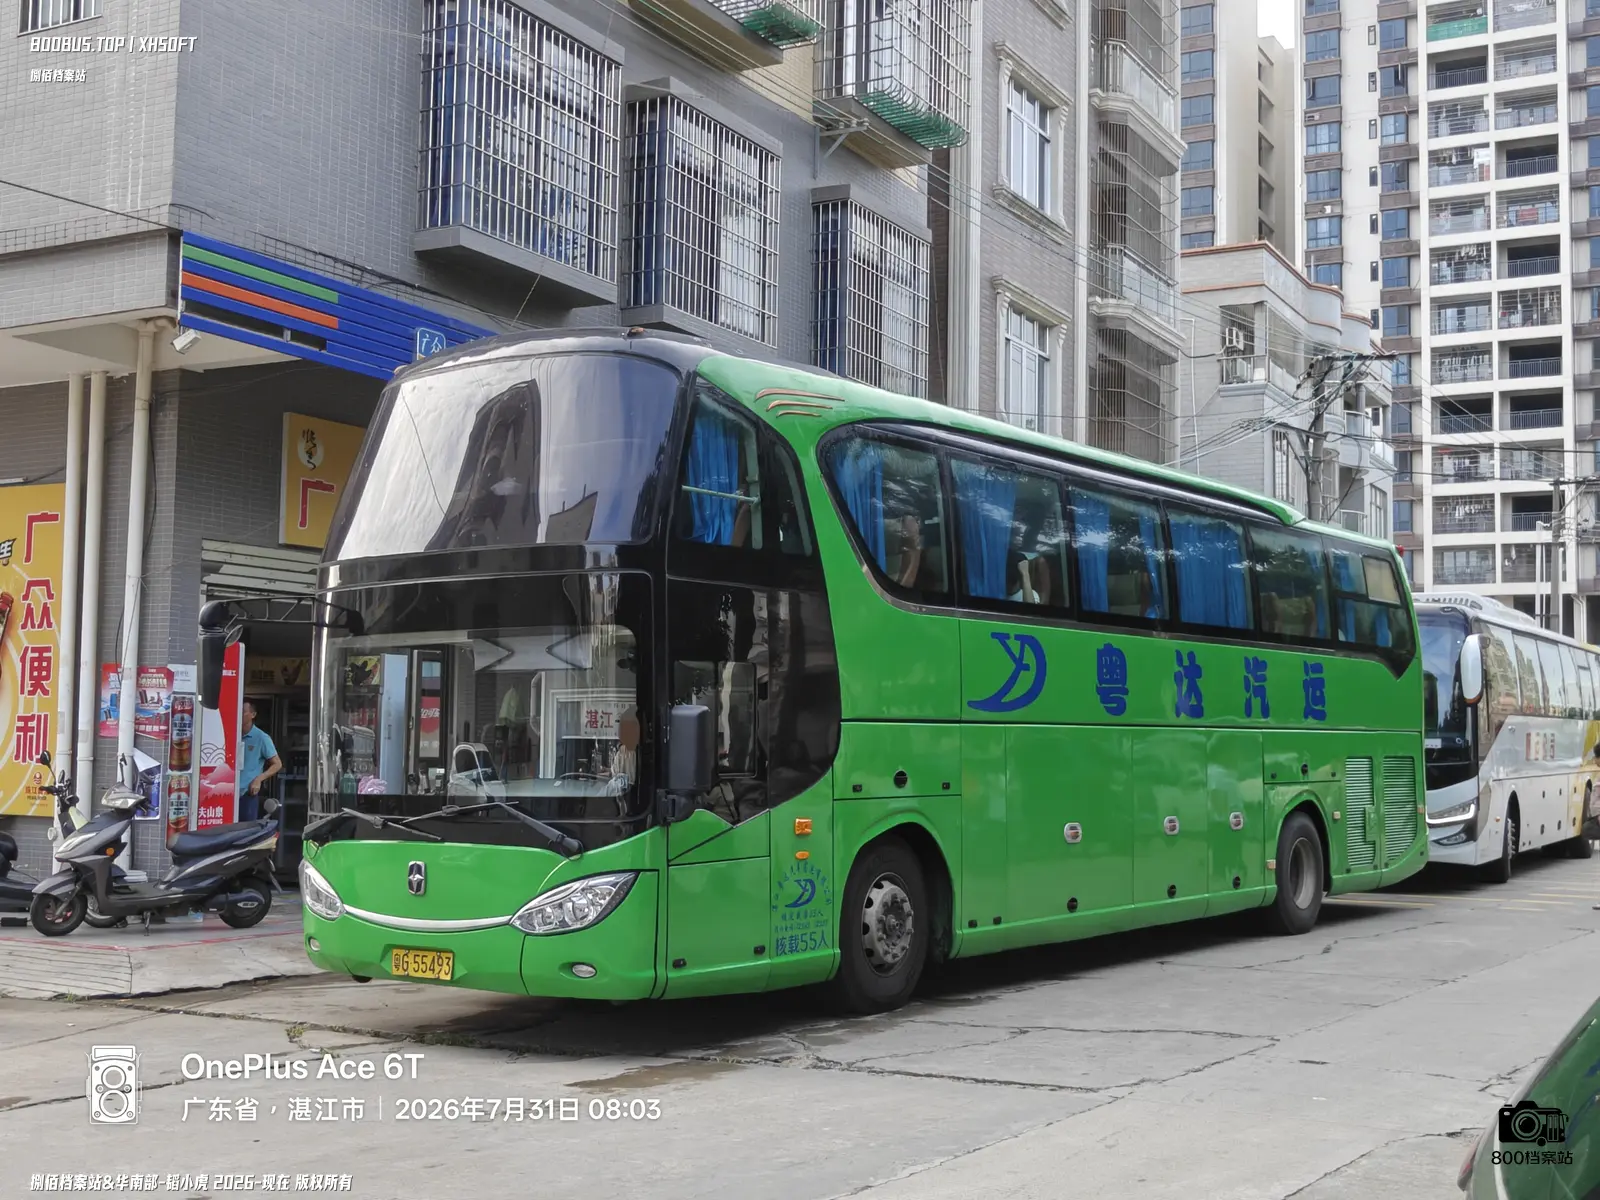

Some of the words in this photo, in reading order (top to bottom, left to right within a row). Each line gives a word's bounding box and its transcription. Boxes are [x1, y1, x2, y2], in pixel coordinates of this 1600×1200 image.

[298, 478, 335, 529] 广
[13, 511, 60, 765] 广众便利
[1095, 642, 1327, 721] 粤达汽运
[585, 709, 613, 728] 湛江
[775, 930, 830, 957] 核载55人
